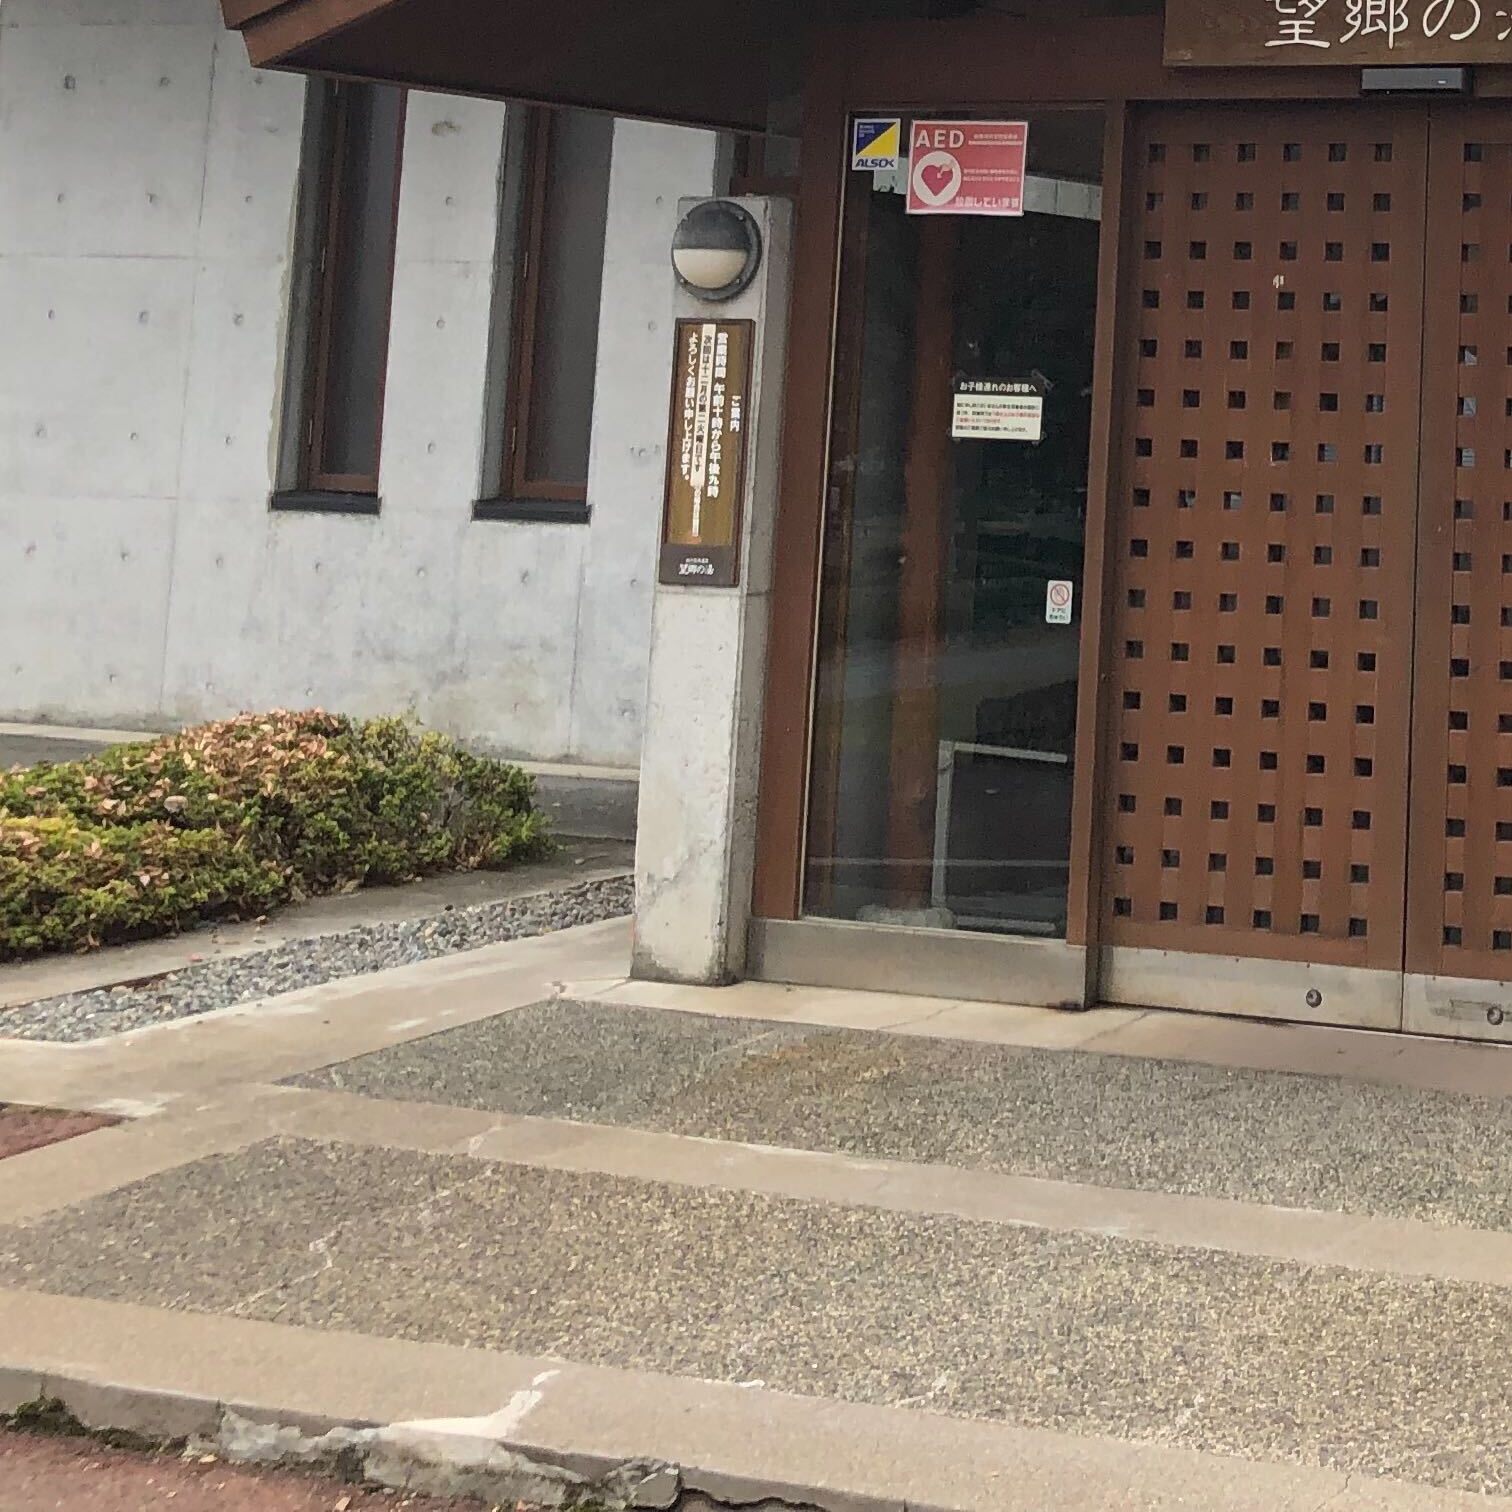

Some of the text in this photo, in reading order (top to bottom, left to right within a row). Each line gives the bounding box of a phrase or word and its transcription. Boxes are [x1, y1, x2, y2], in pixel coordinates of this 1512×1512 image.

[915, 129, 965, 149] AED
[855, 158, 895, 168] ALSOK
[714, 331, 729, 379] 営業時間
[729, 394, 742, 433] ご案内
